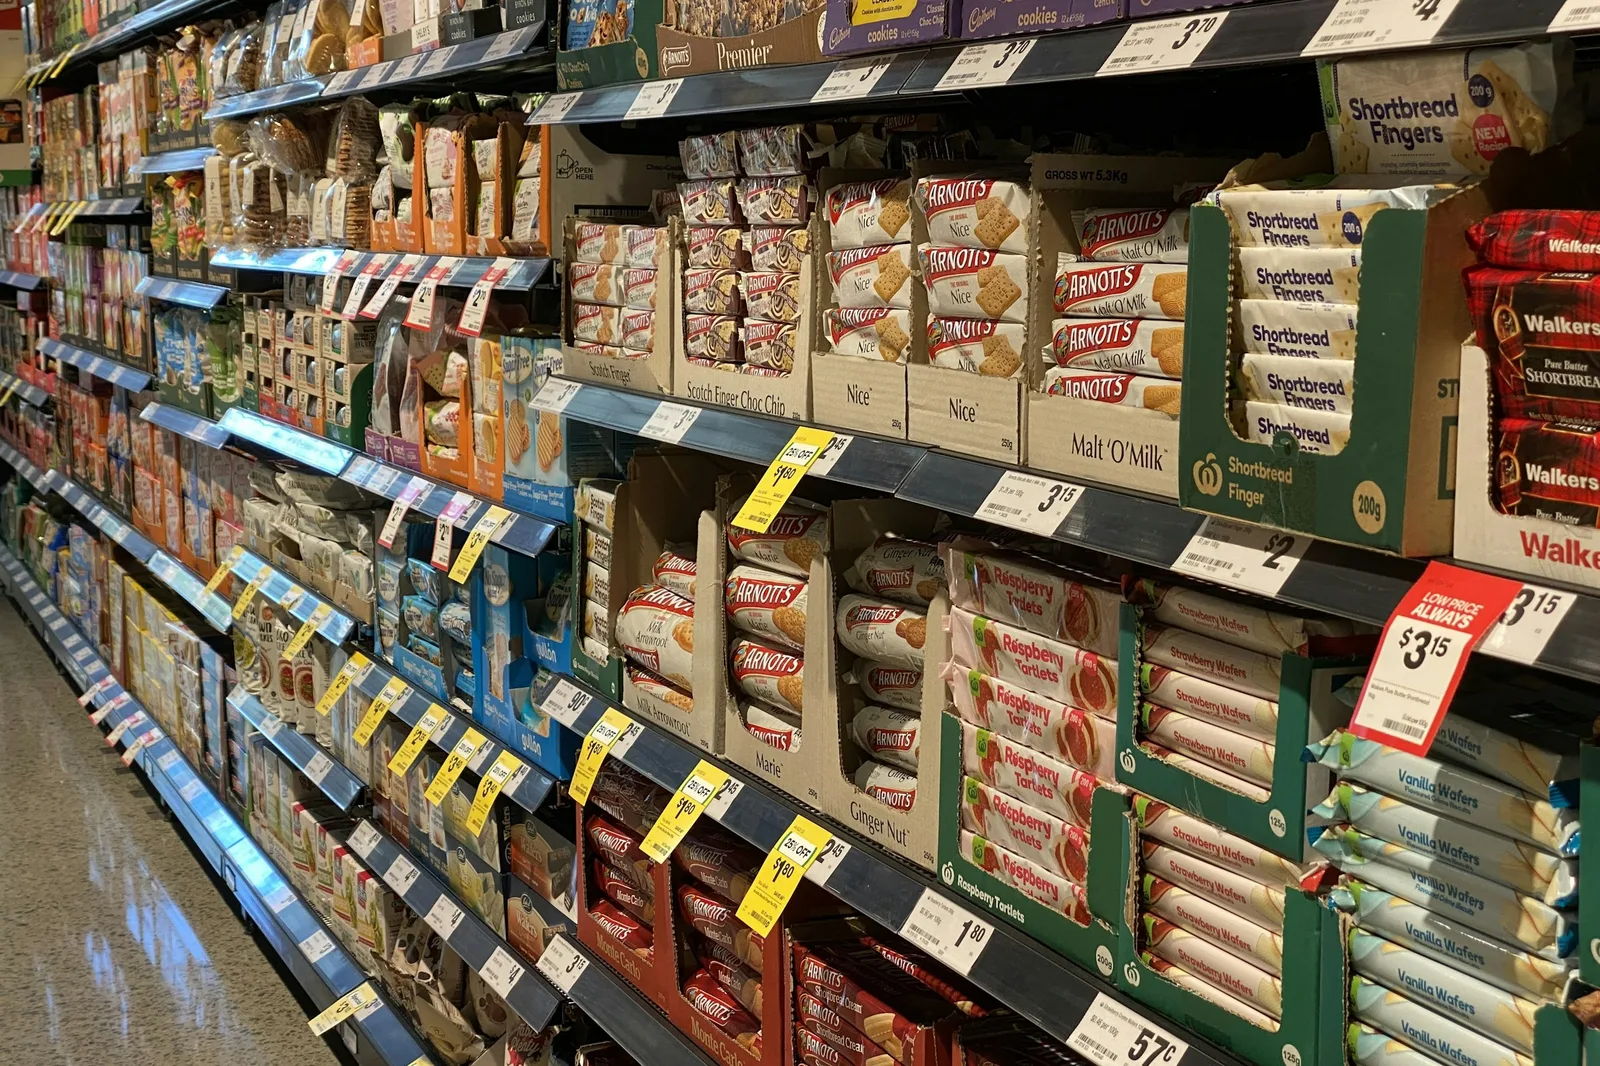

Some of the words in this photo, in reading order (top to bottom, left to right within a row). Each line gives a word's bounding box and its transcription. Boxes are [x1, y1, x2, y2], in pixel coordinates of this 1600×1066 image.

[516, 12, 535, 24] cookies
[919, 16, 931, 27] Choc
[932, 14, 945, 26] Chip
[926, 4, 945, 14] Classic
[968, 7, 997, 33] Cadbury
[1018, 10, 1056, 26] cookies
[451, 29, 467, 40] cookies
[829, 26, 851, 50] Cadbury
[868, 26, 898, 43] cookies
[1348, 93, 1459, 121] Shortbread
[1369, 120, 1444, 150] Fingers
[1475, 126, 1506, 140] NEW
[1045, 170, 1078, 181] GROSS
[1080, 171, 1094, 181] WT
[1096, 170, 1128, 184] 5.3Kg
[929, 180, 987, 207] ARNOTT'S
[858, 214, 874, 230] Nice
[950, 222, 970, 239] Nice
[1096, 209, 1166, 242] ARNOTT'S
[1247, 211, 1318, 230] Shortbread
[1262, 229, 1310, 248] Fingers
[1548, 238, 1600, 254] Walkers
[930, 248, 990, 274] ARNOTT'S
[854, 277, 870, 294] Nice
[1069, 265, 1136, 299] ARNOTT'S
[1256, 268, 1334, 286] Shortbread
[950, 288, 972, 305] Nice
[1272, 285, 1325, 302] Fingers
[1069, 320, 1134, 352] ARNOTT'S
[1252, 324, 1330, 347] Shortbread
[1524, 314, 1600, 336] Walkers
[857, 339, 875, 354] Nice
[518, 354, 530, 370] Free
[589, 360, 609, 379] Scotch
[610, 365, 631, 386] Finger
[1544, 358, 1562, 370] Pure
[1563, 360, 1588, 372] Butter
[846, 383, 870, 406] Nice
[1065, 376, 1124, 401] ARNOTT'S
[1268, 373, 1346, 396] Shortbread
[688, 380, 712, 402] Scotch
[714, 388, 738, 408] Finger
[740, 390, 762, 412] Choc
[764, 395, 786, 416] Chip
[949, 398, 976, 422] Nice
[1284, 391, 1336, 412] Fingers
[892, 419, 902, 430] 250g
[797, 449, 814, 462] OFF
[1002, 438, 1012, 452] 250g
[1228, 456, 1293, 484] Shortbread
[1526, 463, 1600, 490] Walkers
[590, 493, 605, 509] Scotch
[1228, 482, 1264, 508] Finger
[590, 507, 604, 524] Finger
[1358, 494, 1381, 522] 200g
[1536, 508, 1553, 520] Pure
[754, 550, 779, 564] Marie
[883, 546, 916, 560] Ginger
[736, 581, 796, 604] ARNOTT'S
[994, 566, 1054, 604] Raspberry
[1006, 590, 1043, 616] Tartlets
[1422, 591, 1448, 608] LOW
[1448, 598, 1484, 616] PRICE
[748, 617, 769, 633] Marie
[1178, 602, 1220, 625] Strawberry
[1220, 618, 1249, 634] Wafers
[1411, 602, 1474, 630] ALWAYS
[636, 632, 668, 648] Arrowroot
[856, 630, 874, 642] Ginger
[874, 630, 886, 640] Nut
[744, 651, 798, 672] ARNOTT'S
[1002, 634, 1064, 673] Raspberry
[1170, 646, 1216, 672] Strawberry
[1215, 660, 1247, 680] Wafers
[878, 670, 916, 686] ARNOTT'S
[1015, 658, 1059, 684] Tartlets
[636, 696, 650, 714] Milk
[652, 704, 690, 737] Arrowroot
[996, 686, 1051, 726] Raspberry
[1176, 688, 1220, 714] Strawberry
[1220, 702, 1252, 722] Wafers
[876, 732, 912, 748] ARNOTT'S
[1173, 730, 1218, 757] Strawberry
[1218, 748, 1246, 768] Wafers
[1446, 727, 1482, 756] Wafers
[755, 751, 782, 778] Marie
[1004, 746, 1060, 789] Raspberry
[698, 784, 710, 797] OFF
[1014, 772, 1054, 800] Tartlets
[1398, 768, 1436, 794] Vanilla
[1438, 782, 1478, 809] Wafers
[504, 806, 512, 840] Wafers
[850, 801, 884, 834] Ginger
[886, 822, 908, 847] Nut
[993, 794, 1052, 840] Raspberry
[1270, 816, 1286, 832] 125g
[796, 843, 812, 860] OFF
[1172, 826, 1220, 855] Strawberry
[1221, 844, 1256, 866] Wafers
[1398, 824, 1436, 850] Vanilla
[1438, 839, 1480, 866] Wafers
[700, 872, 718, 884] Monte
[1002, 854, 1058, 902] Raspberry
[1170, 860, 1214, 892] Strawberry
[1214, 881, 1246, 904] Wafers
[1408, 868, 1446, 891] Vanilla
[1446, 884, 1485, 911] Wafers
[617, 890, 632, 903] Monte
[631, 894, 644, 908] Carlo
[693, 899, 730, 921] ARNOTT'S
[957, 877, 994, 906] Raspberry
[994, 896, 1026, 924] Tartlets
[1414, 884, 1440, 900] Flavoured
[1453, 900, 1474, 916] Biscuits
[1176, 906, 1220, 938] Strawberry
[1220, 928, 1252, 952] Wafers
[1405, 921, 1442, 948] Vanilla
[1443, 937, 1485, 966] Wafers
[596, 931, 620, 962] Monte
[620, 952, 642, 981] Carlo
[1096, 954, 1113, 971] 200g
[1398, 968, 1436, 996] Vanilla
[1436, 985, 1476, 1016] Wafers
[690, 1016, 720, 1054] Monte
[720, 1042, 744, 1066] Carlo
[1400, 1020, 1438, 1046] Vanilla
[1438, 1037, 1478, 1066] Wafers
